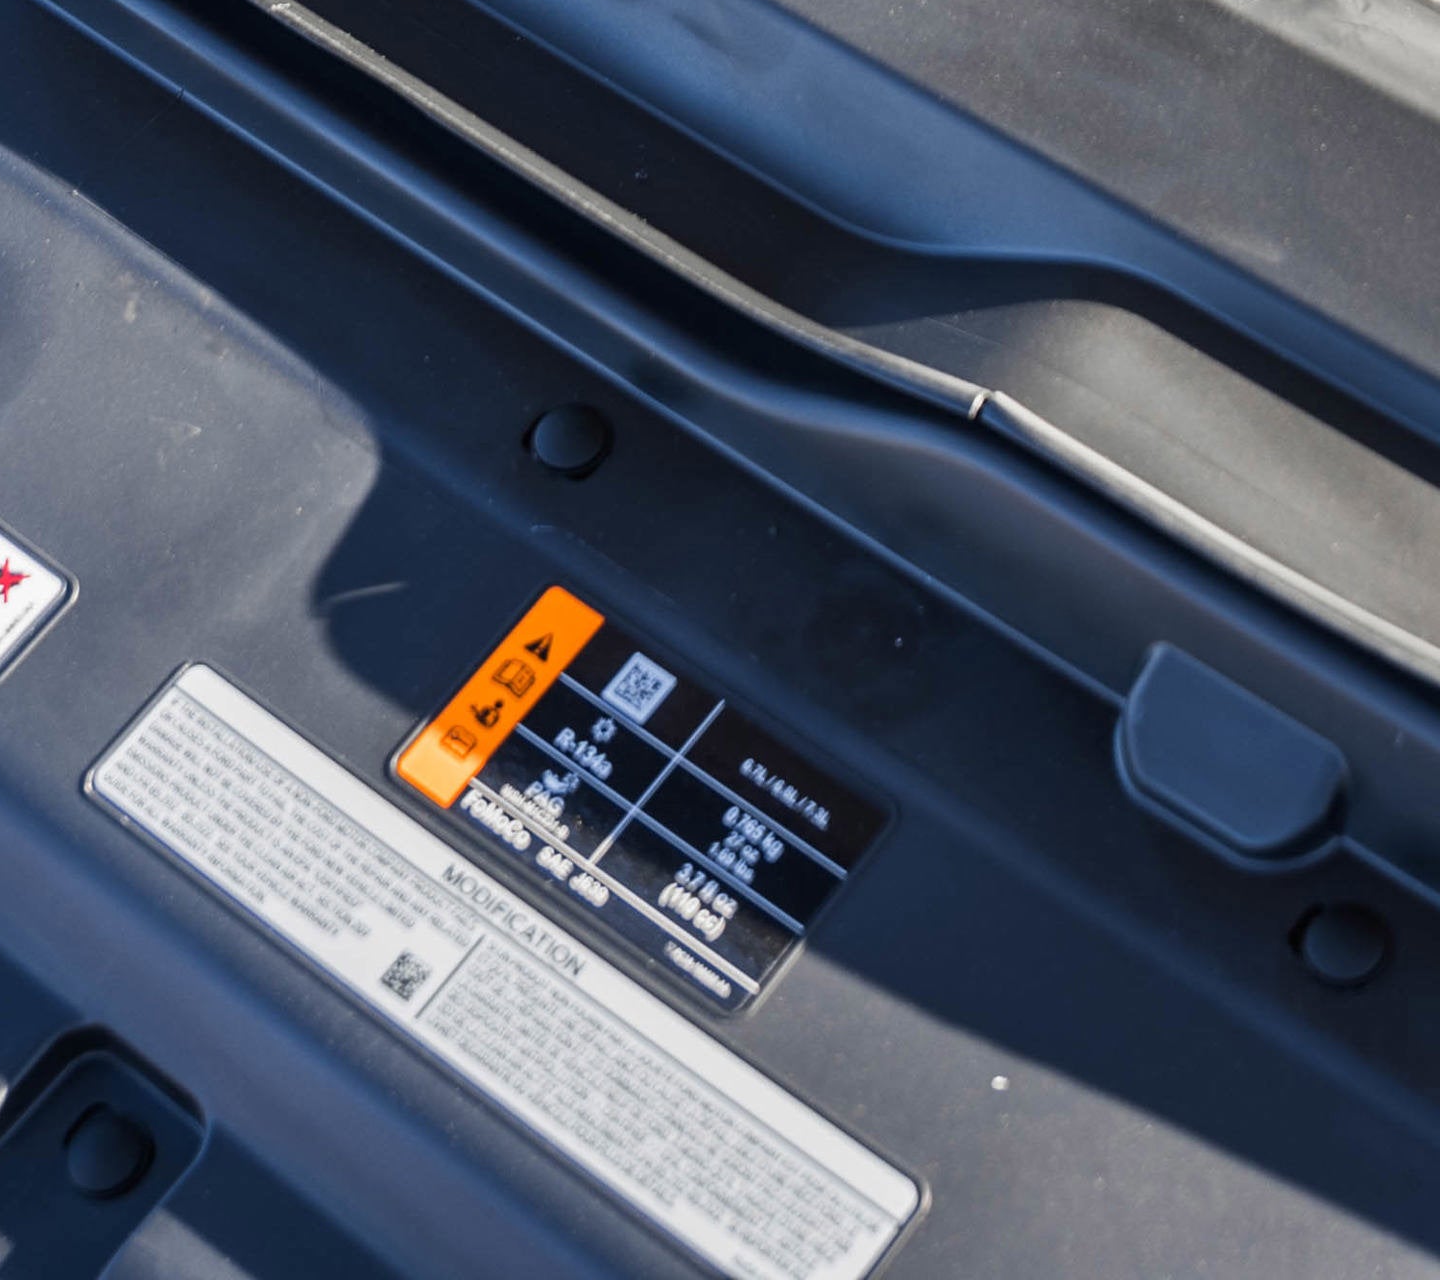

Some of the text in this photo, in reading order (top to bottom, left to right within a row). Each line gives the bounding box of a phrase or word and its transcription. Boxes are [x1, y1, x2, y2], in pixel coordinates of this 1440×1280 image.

[551, 724, 617, 781] R-134a
[523, 780, 567, 819] PAG
[458, 786, 536, 852] FoMoCo
[533, 842, 576, 882] SAE
[718, 804, 786, 864] 0.765 kg
[440, 862, 587, 978] MODIFICATION
[671, 860, 707, 894] 3.7
[709, 890, 741, 920] oz
